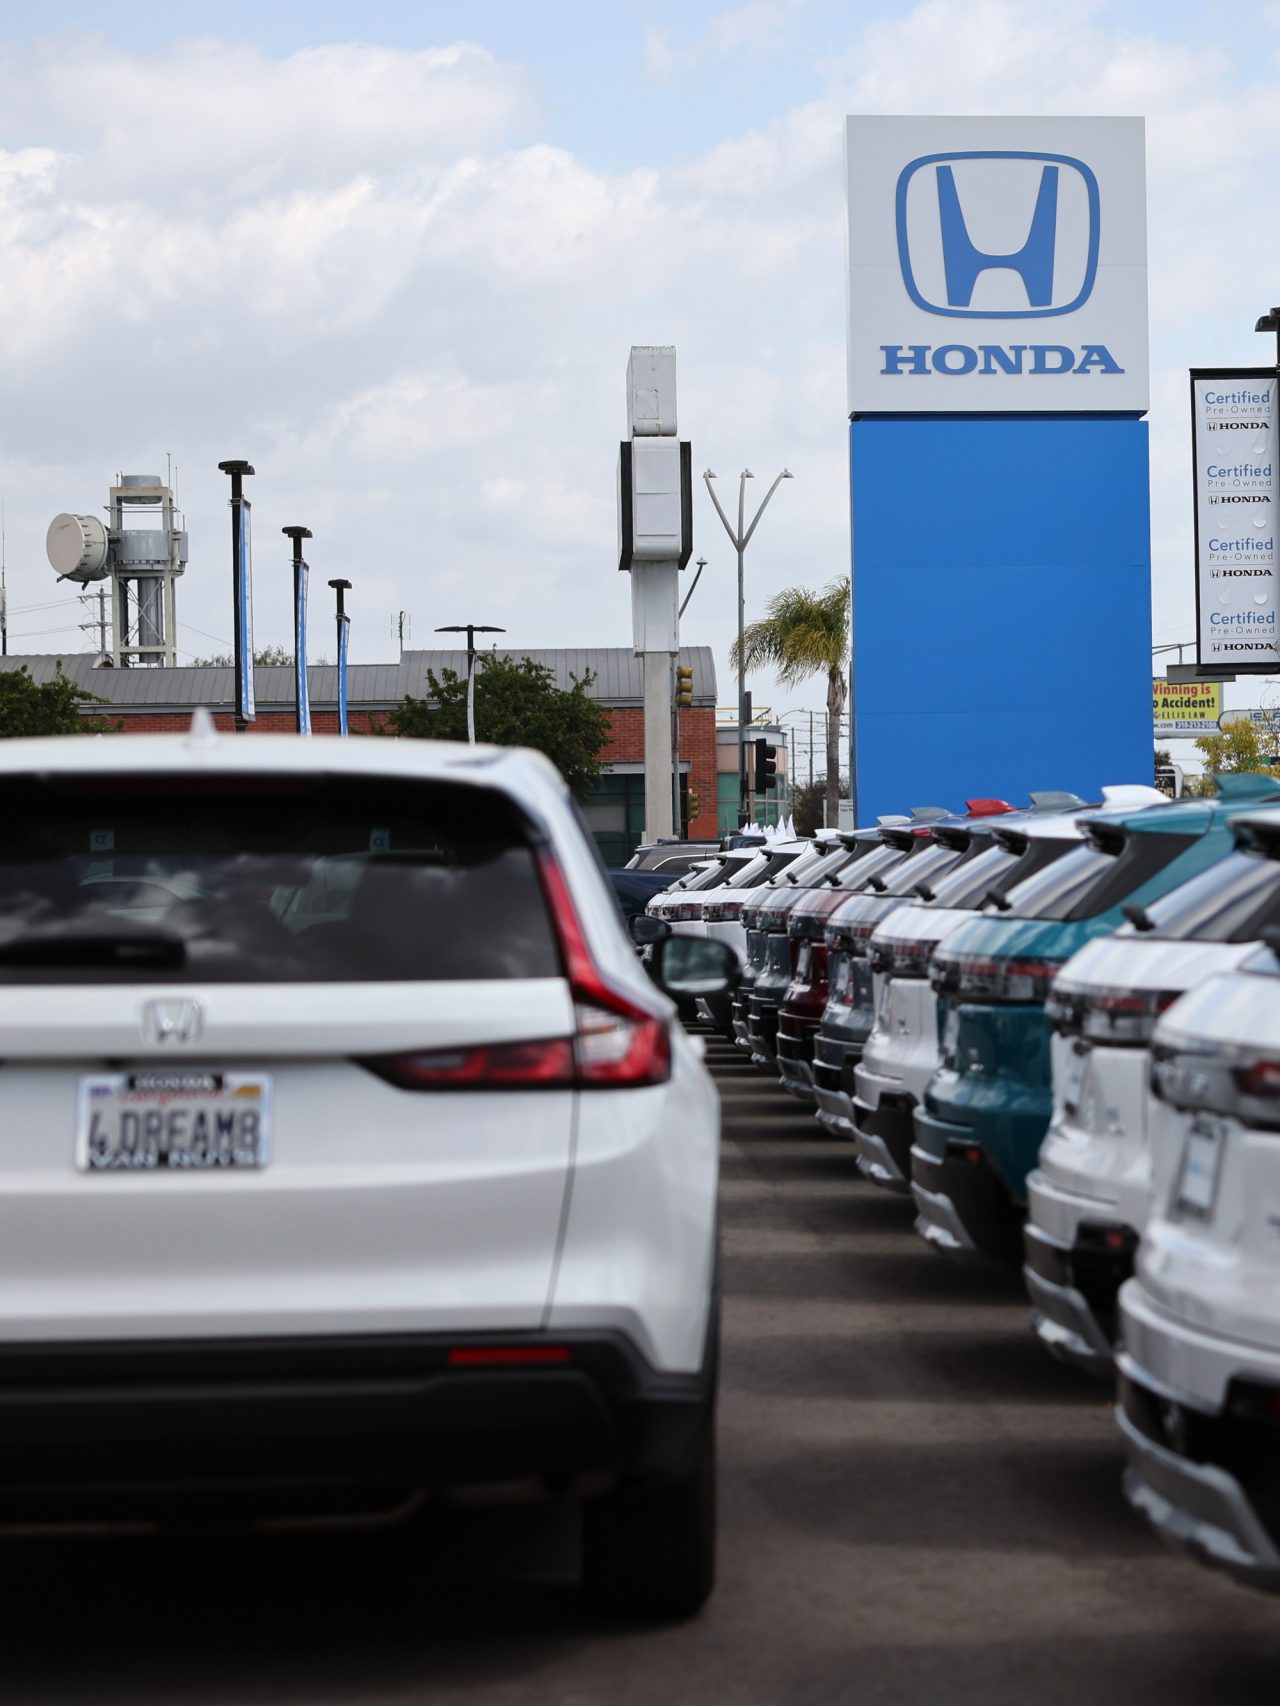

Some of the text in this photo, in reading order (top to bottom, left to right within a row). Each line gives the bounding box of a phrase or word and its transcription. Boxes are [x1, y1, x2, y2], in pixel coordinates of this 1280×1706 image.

[880, 345, 1125, 375] HONDA
[1205, 389, 1271, 405] Certified
[1207, 463, 1273, 478] Certified
[1209, 537, 1274, 552] Certified
[1210, 610, 1275, 625] Certified
[1201, 683, 1211, 694] is
[1162, 697, 1214, 708] Accident!
